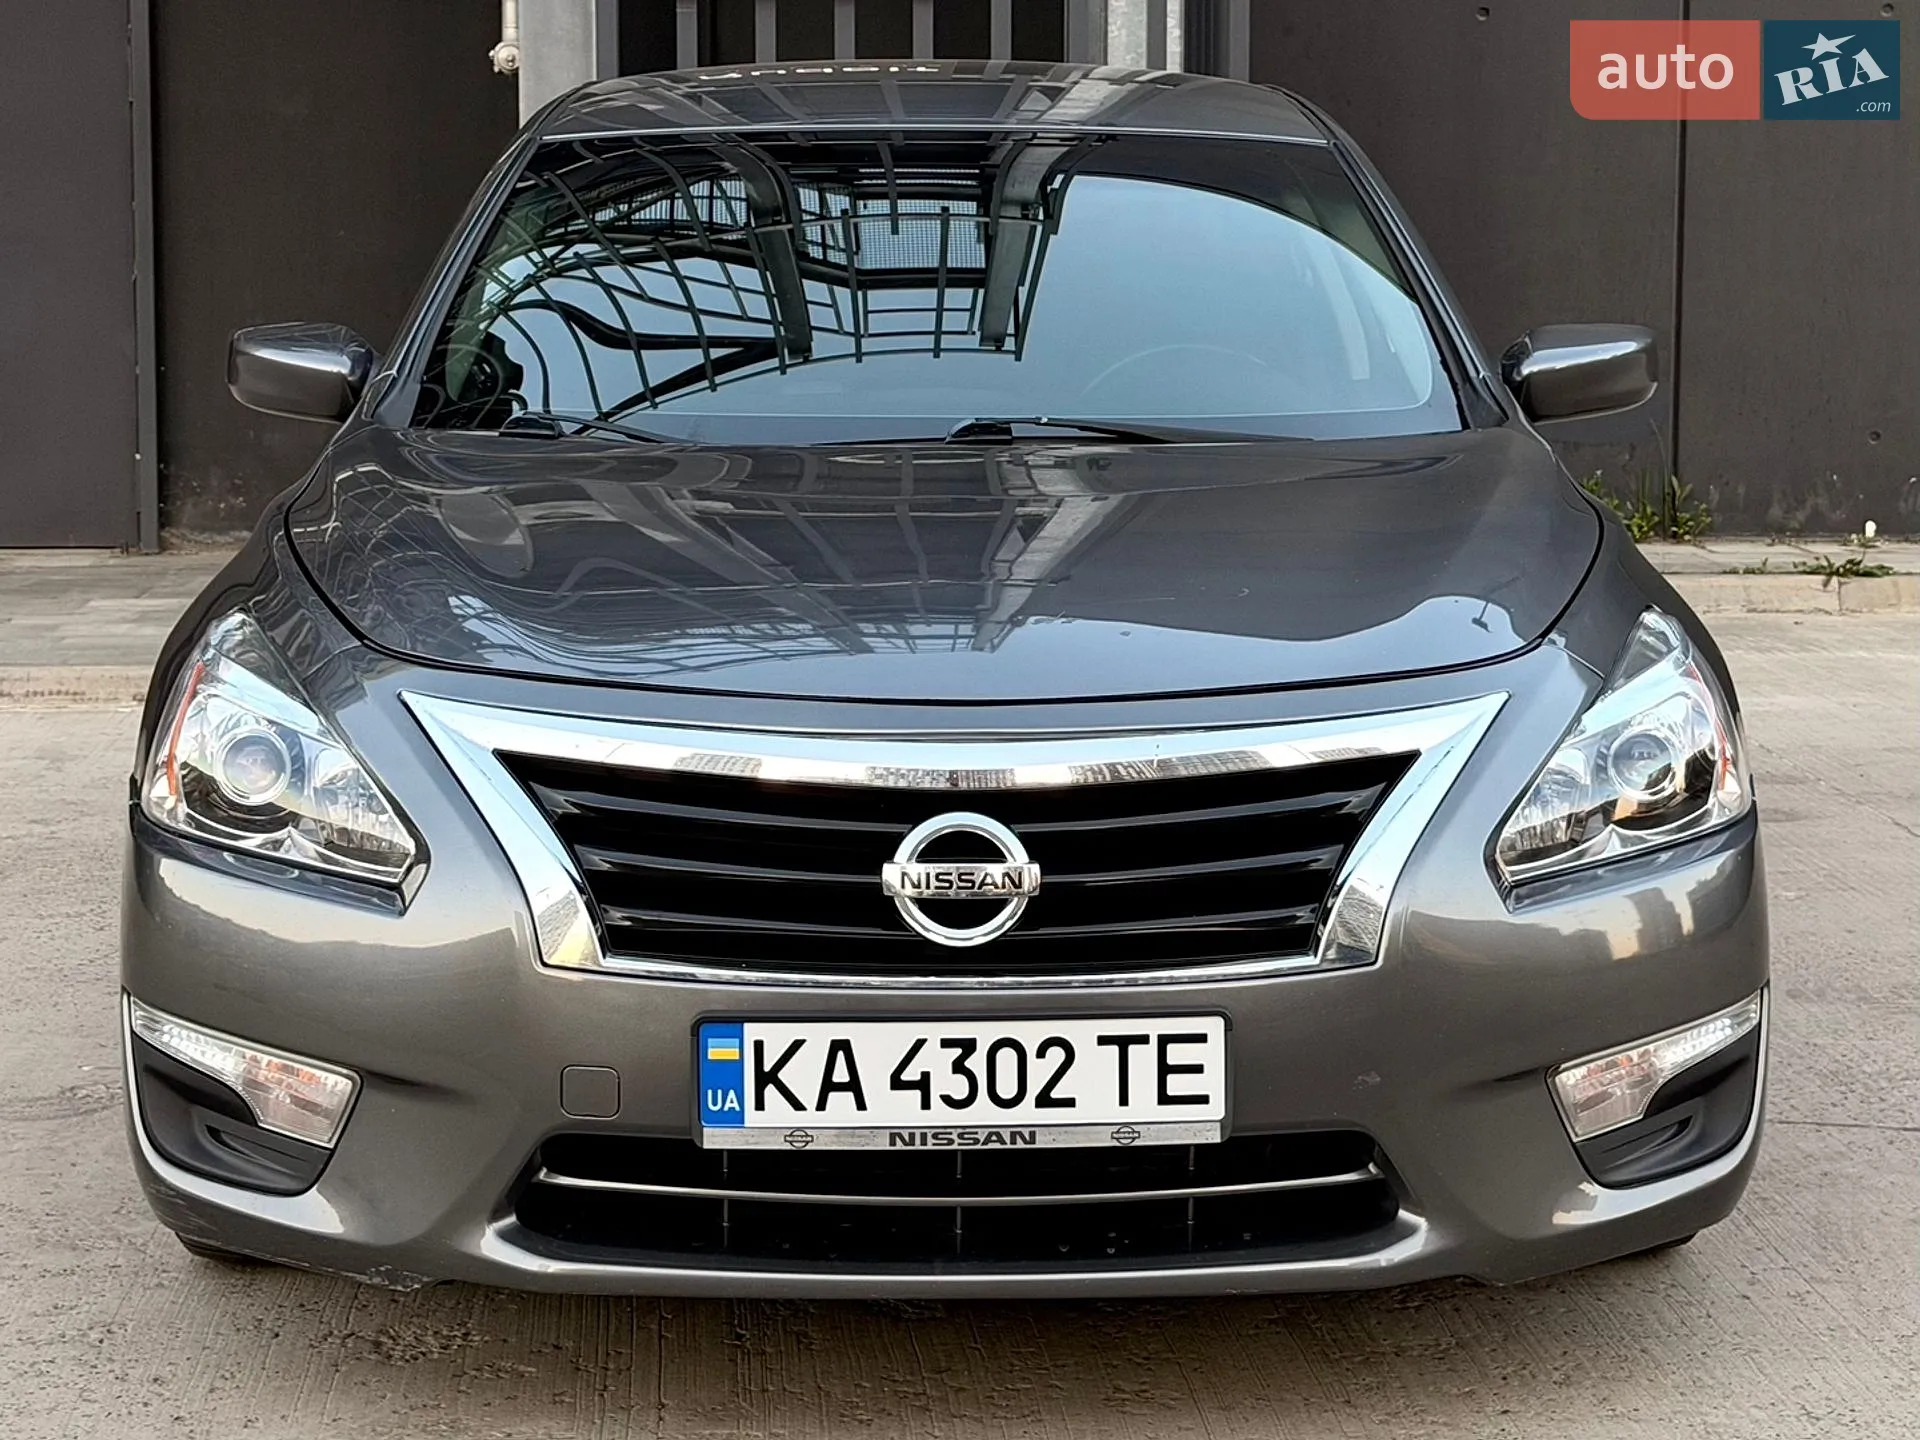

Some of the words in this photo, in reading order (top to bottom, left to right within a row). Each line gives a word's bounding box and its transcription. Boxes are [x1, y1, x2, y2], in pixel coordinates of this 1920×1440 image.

[900, 870, 1024, 890] NISSAN
[753, 1038, 868, 1112] KA
[890, 1036, 1077, 1110] 4302
[1096, 1032, 1211, 1107] TE
[707, 1089, 739, 1111] UA
[888, 1130, 1037, 1147] NISSAN
